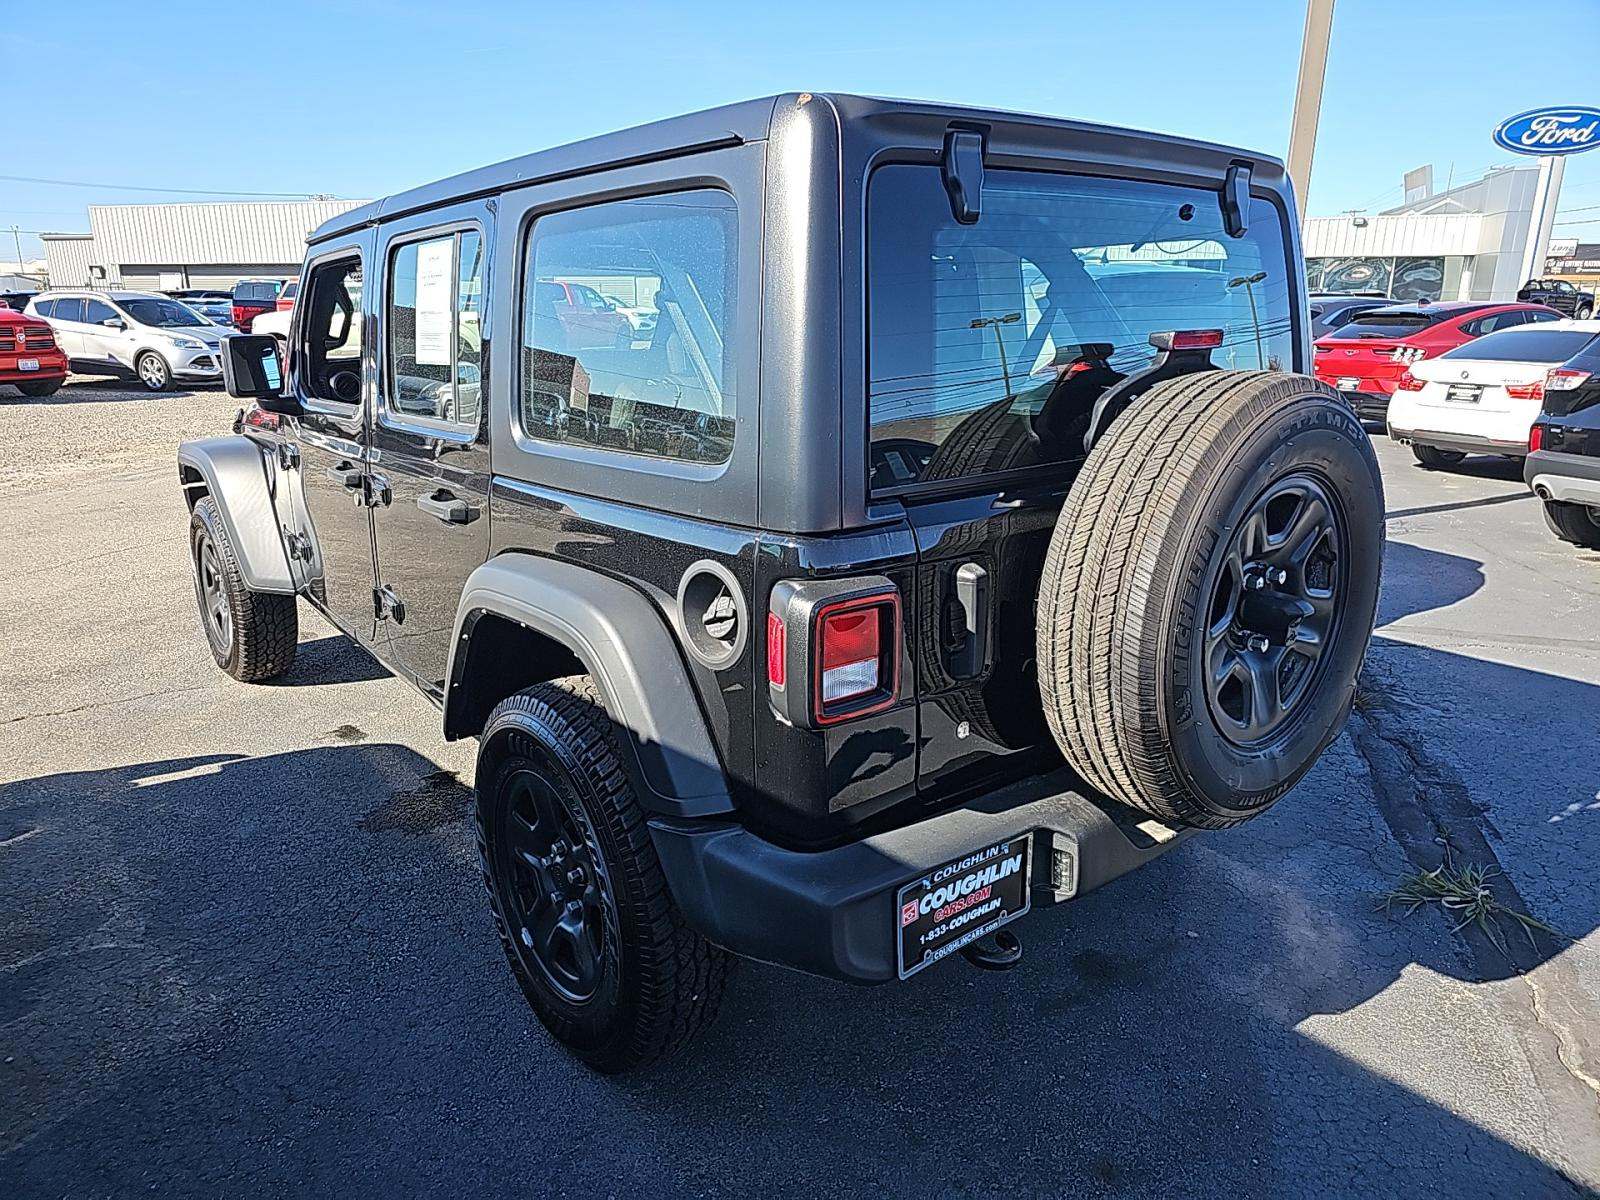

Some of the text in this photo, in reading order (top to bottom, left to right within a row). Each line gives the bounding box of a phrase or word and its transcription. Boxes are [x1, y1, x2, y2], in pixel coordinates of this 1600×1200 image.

[1521, 115, 1599, 145] Ford
[1173, 524, 1220, 687] MICHELIN
[919, 853, 1023, 915] COUGHLIN
[934, 846, 999, 882] COUGHLIN
[919, 898, 1002, 945] 1-833-COUGHLIN
